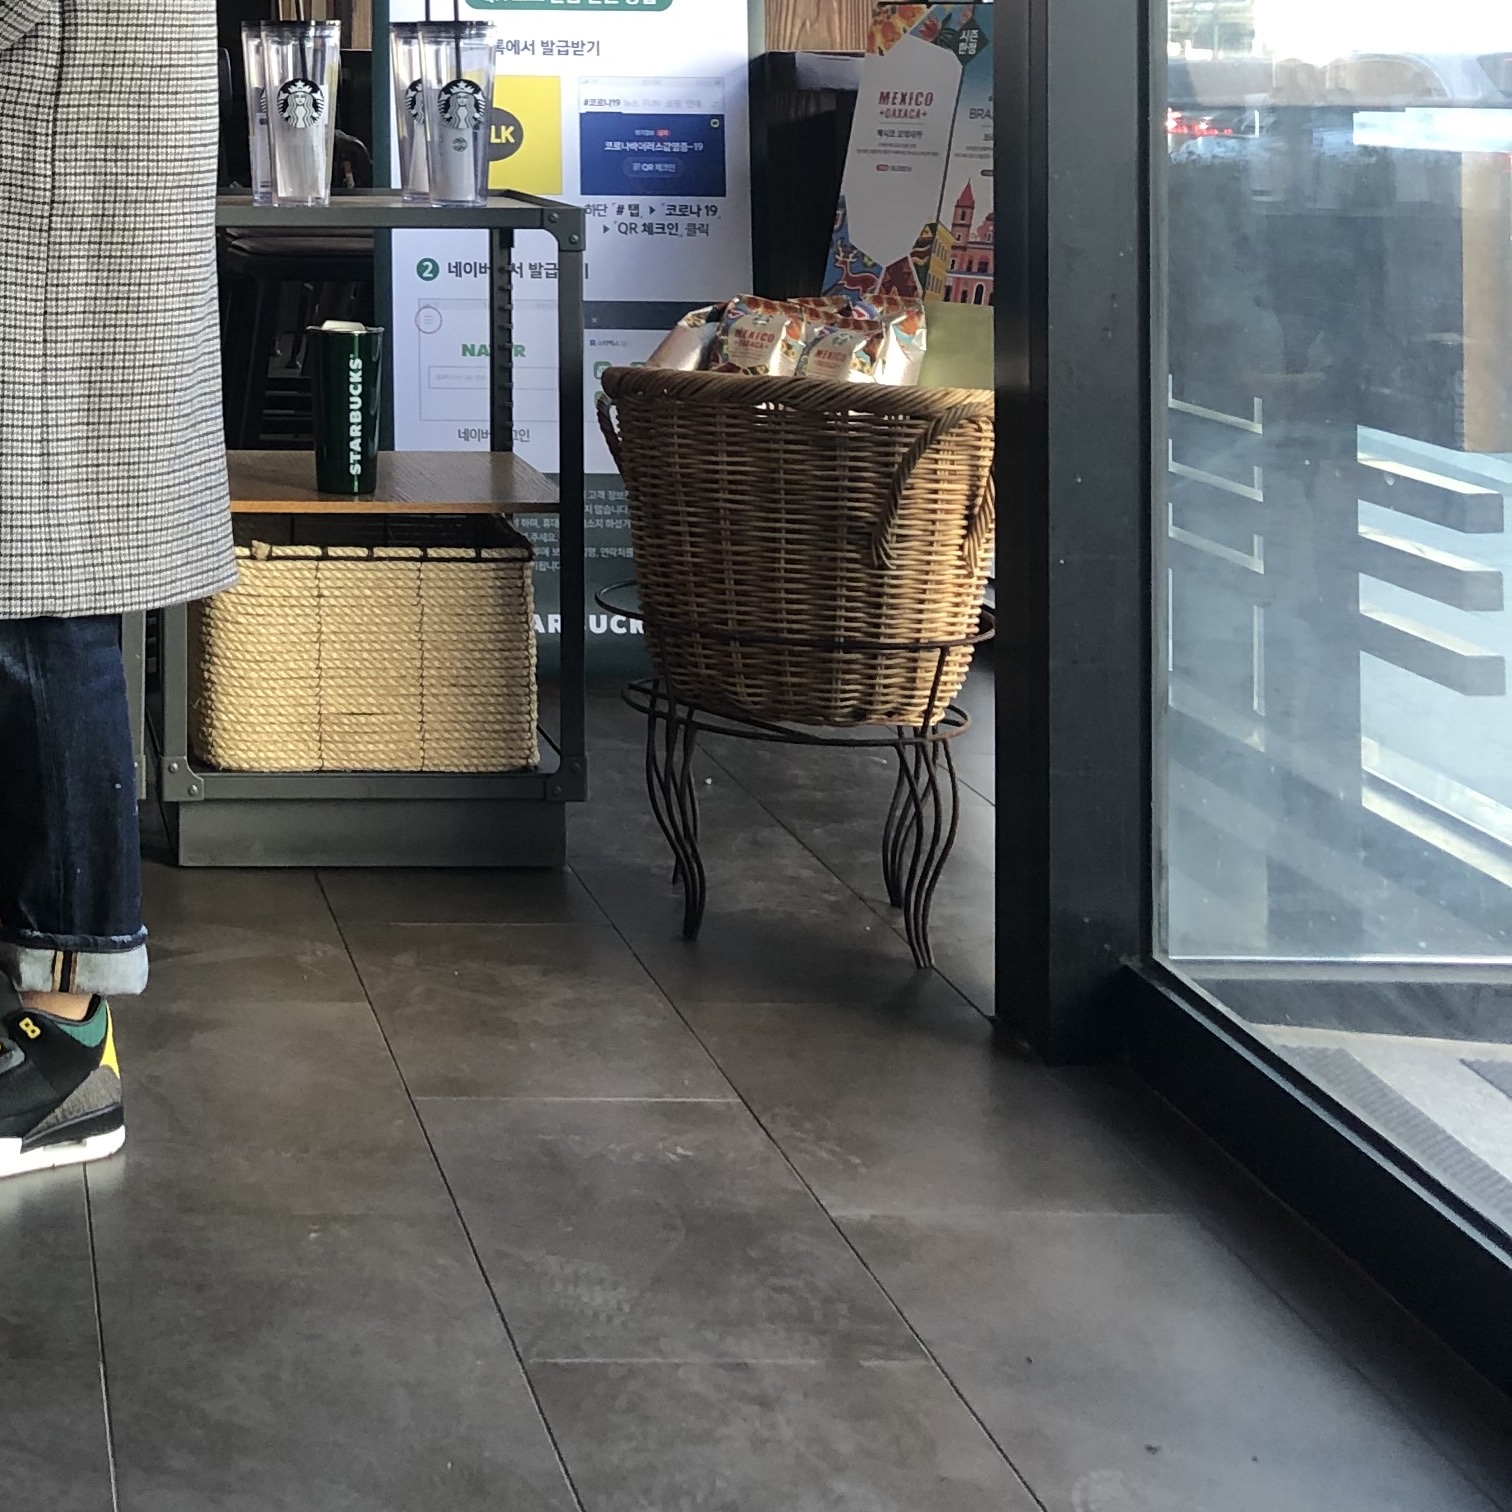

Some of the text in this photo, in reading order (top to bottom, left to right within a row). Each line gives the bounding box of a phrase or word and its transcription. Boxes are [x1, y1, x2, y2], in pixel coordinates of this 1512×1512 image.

[960, 29, 979, 43] 시즌
[540, 39, 600, 56] 발급받기
[958, 42, 977, 55] 한정
[583, 98, 620, 107] #코로나19
[878, 91, 934, 107] MEXICO
[490, 125, 515, 144] LK
[586, 203, 608, 217] 하단
[685, 223, 710, 237] 클릭
[422, 260, 434, 278] 2
[448, 262, 524, 279] 네이버서
[734, 328, 776, 344] MEXICO
[461, 344, 526, 357] NAR
[349, 357, 363, 476] STARBUCKS
[608, 491, 629, 501] 정보
